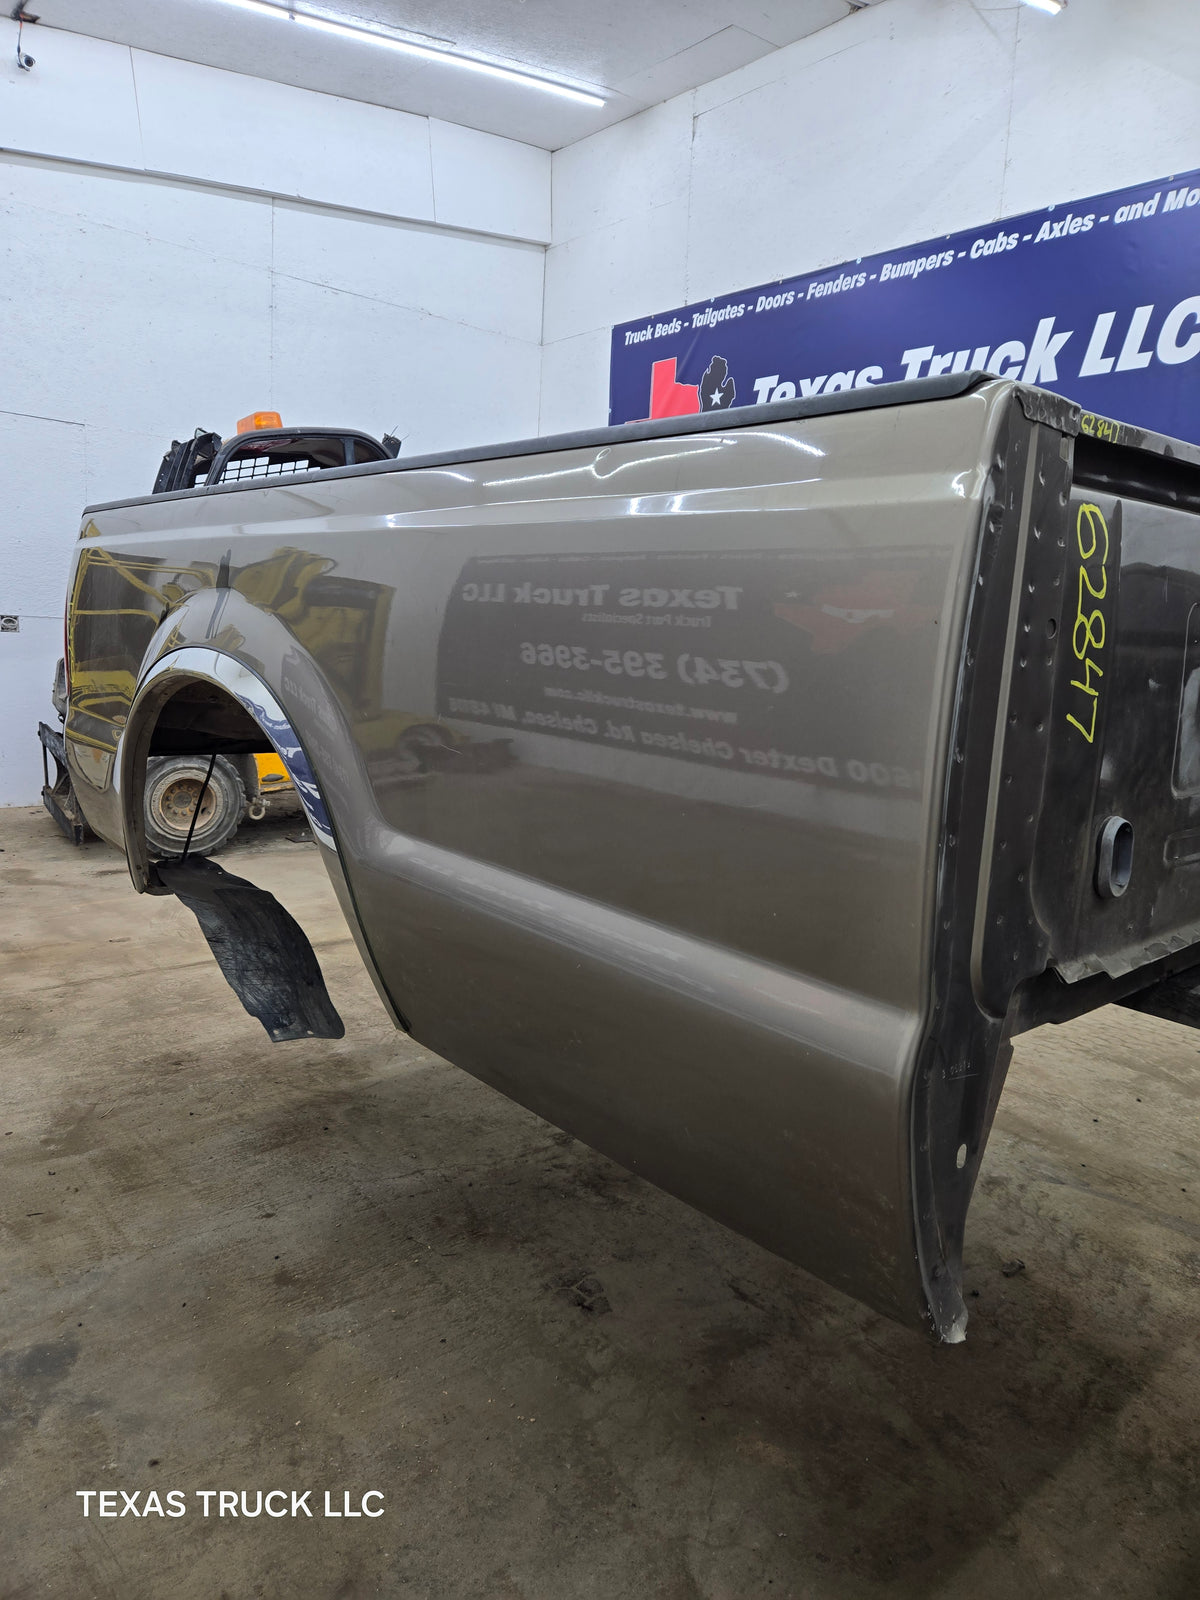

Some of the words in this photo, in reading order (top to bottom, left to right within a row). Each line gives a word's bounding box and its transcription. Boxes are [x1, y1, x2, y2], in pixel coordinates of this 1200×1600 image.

[625, 325, 653, 345] Truck
[654, 318, 681, 339] Beds
[692, 303, 745, 328] Tailgates
[755, 290, 795, 312] Doors
[806, 271, 867, 300] Fenders
[879, 249, 955, 282] Bumpers
[970, 232, 1019, 259] Cabs
[1033, 214, 1095, 243] Axles
[1114, 192, 1161, 224] and
[1162, 186, 1200, 213] Mo
[1078, 295, 1200, 377] LLC
[1081, 414, 1120, 443] 62847
[1066, 503, 1109, 743] 62847
